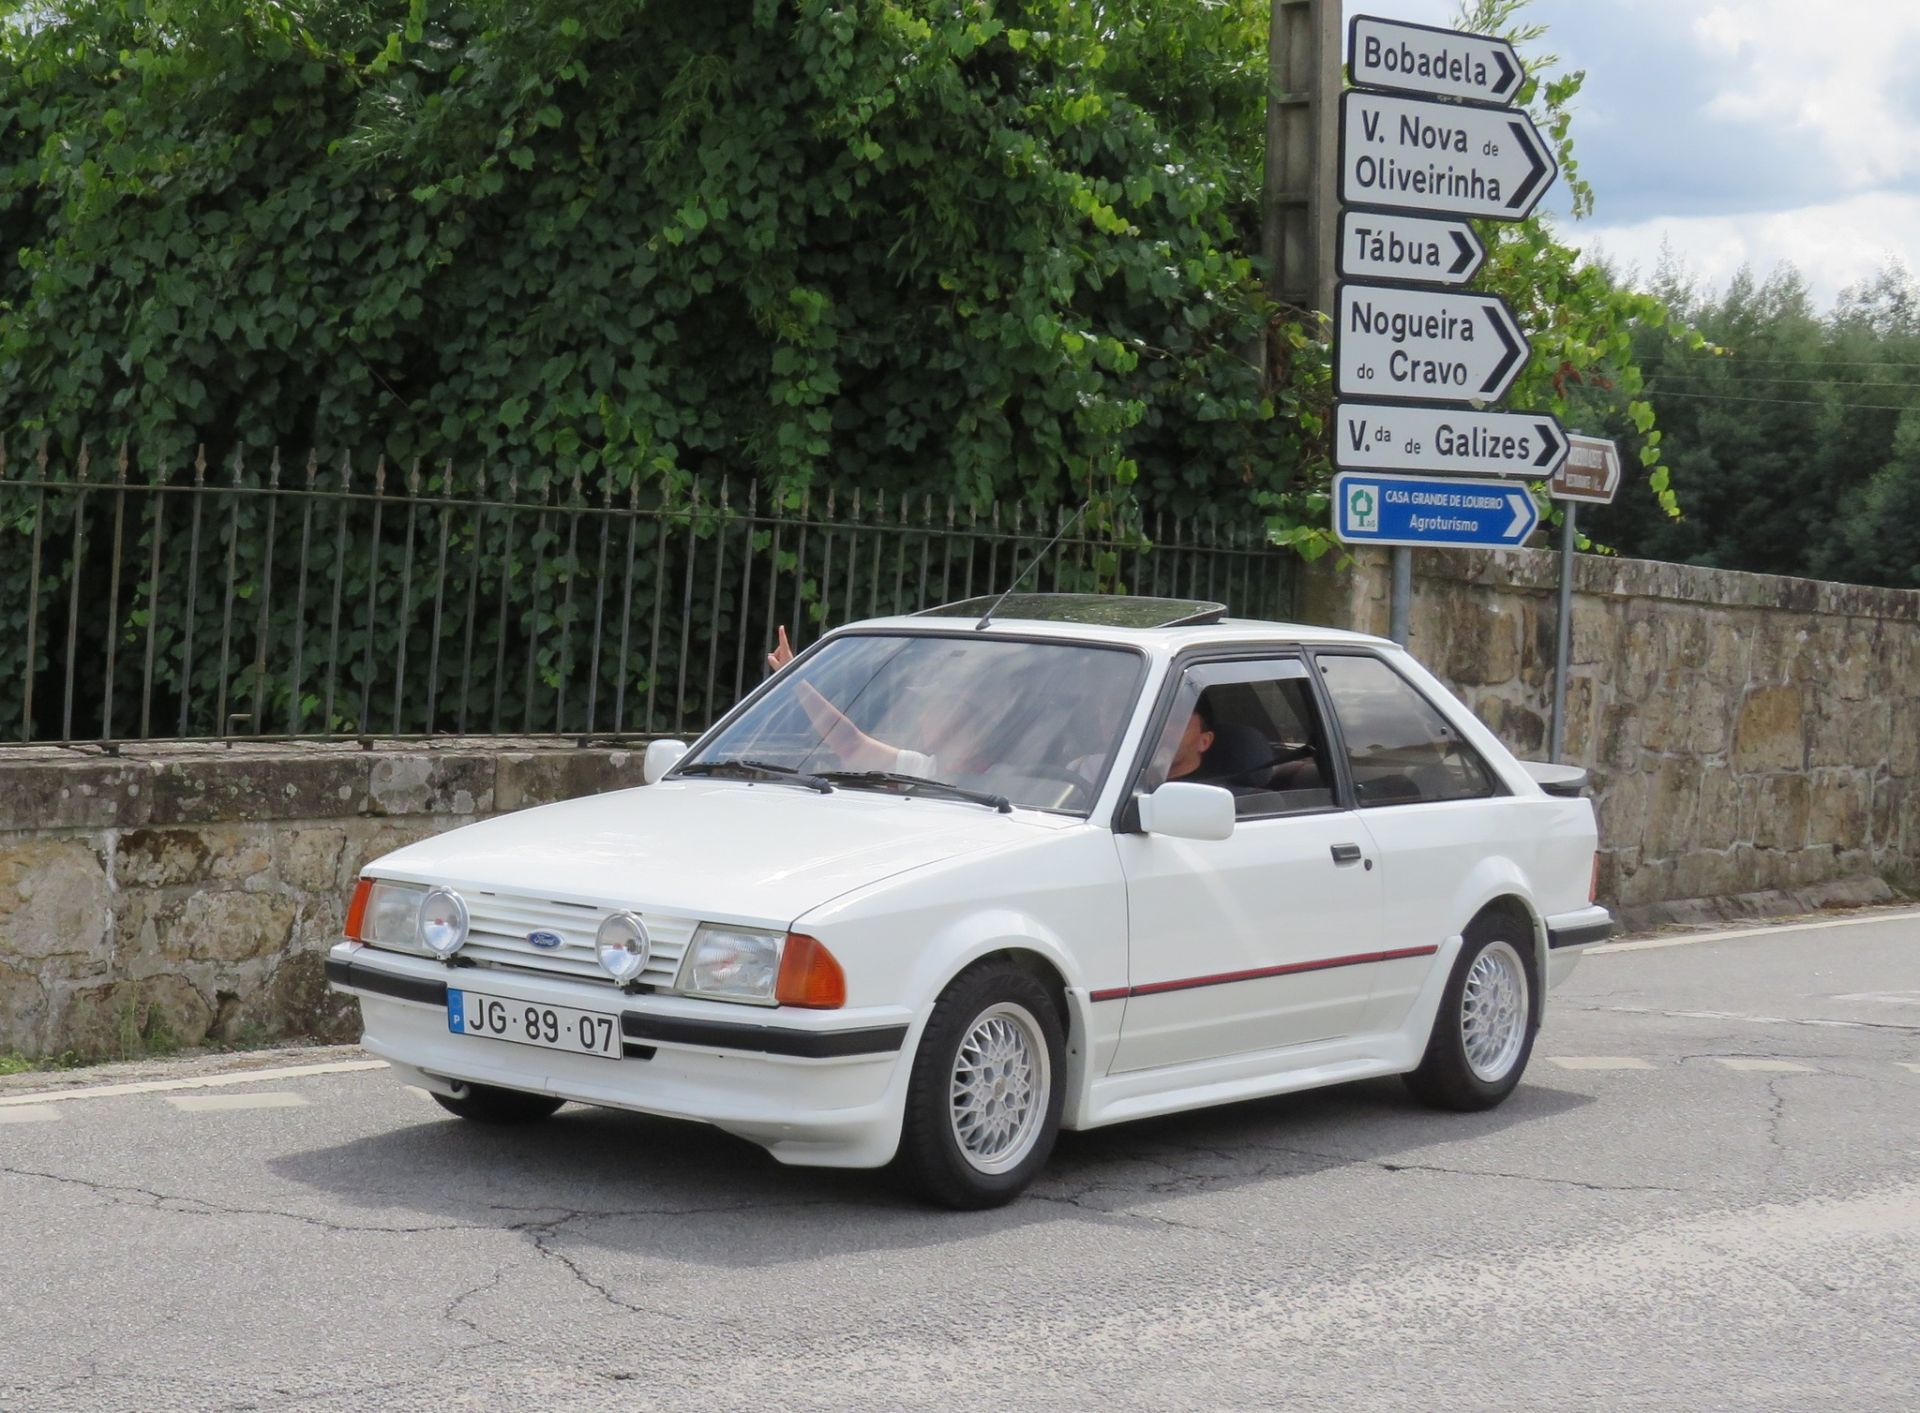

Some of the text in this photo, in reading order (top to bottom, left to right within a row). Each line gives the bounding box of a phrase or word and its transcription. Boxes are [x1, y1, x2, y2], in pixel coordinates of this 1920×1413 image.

[1364, 36, 1487, 86] Bobadela
[1362, 110, 1499, 157] V. Nova de
[1355, 155, 1500, 201] Oliveirinha
[1355, 228, 1440, 266] Tábua
[1351, 301, 1474, 342] Nogueira
[1357, 350, 1467, 386] do Cravo
[1404, 438, 1421, 455] de
[1435, 424, 1530, 460] Galizes
[1385, 490, 1504, 510] CASA GRANDE DE LOUREIRO
[1409, 514, 1479, 532] Agroturismo
[534, 932, 557, 946] Ford
[453, 1014, 460, 1025] P
